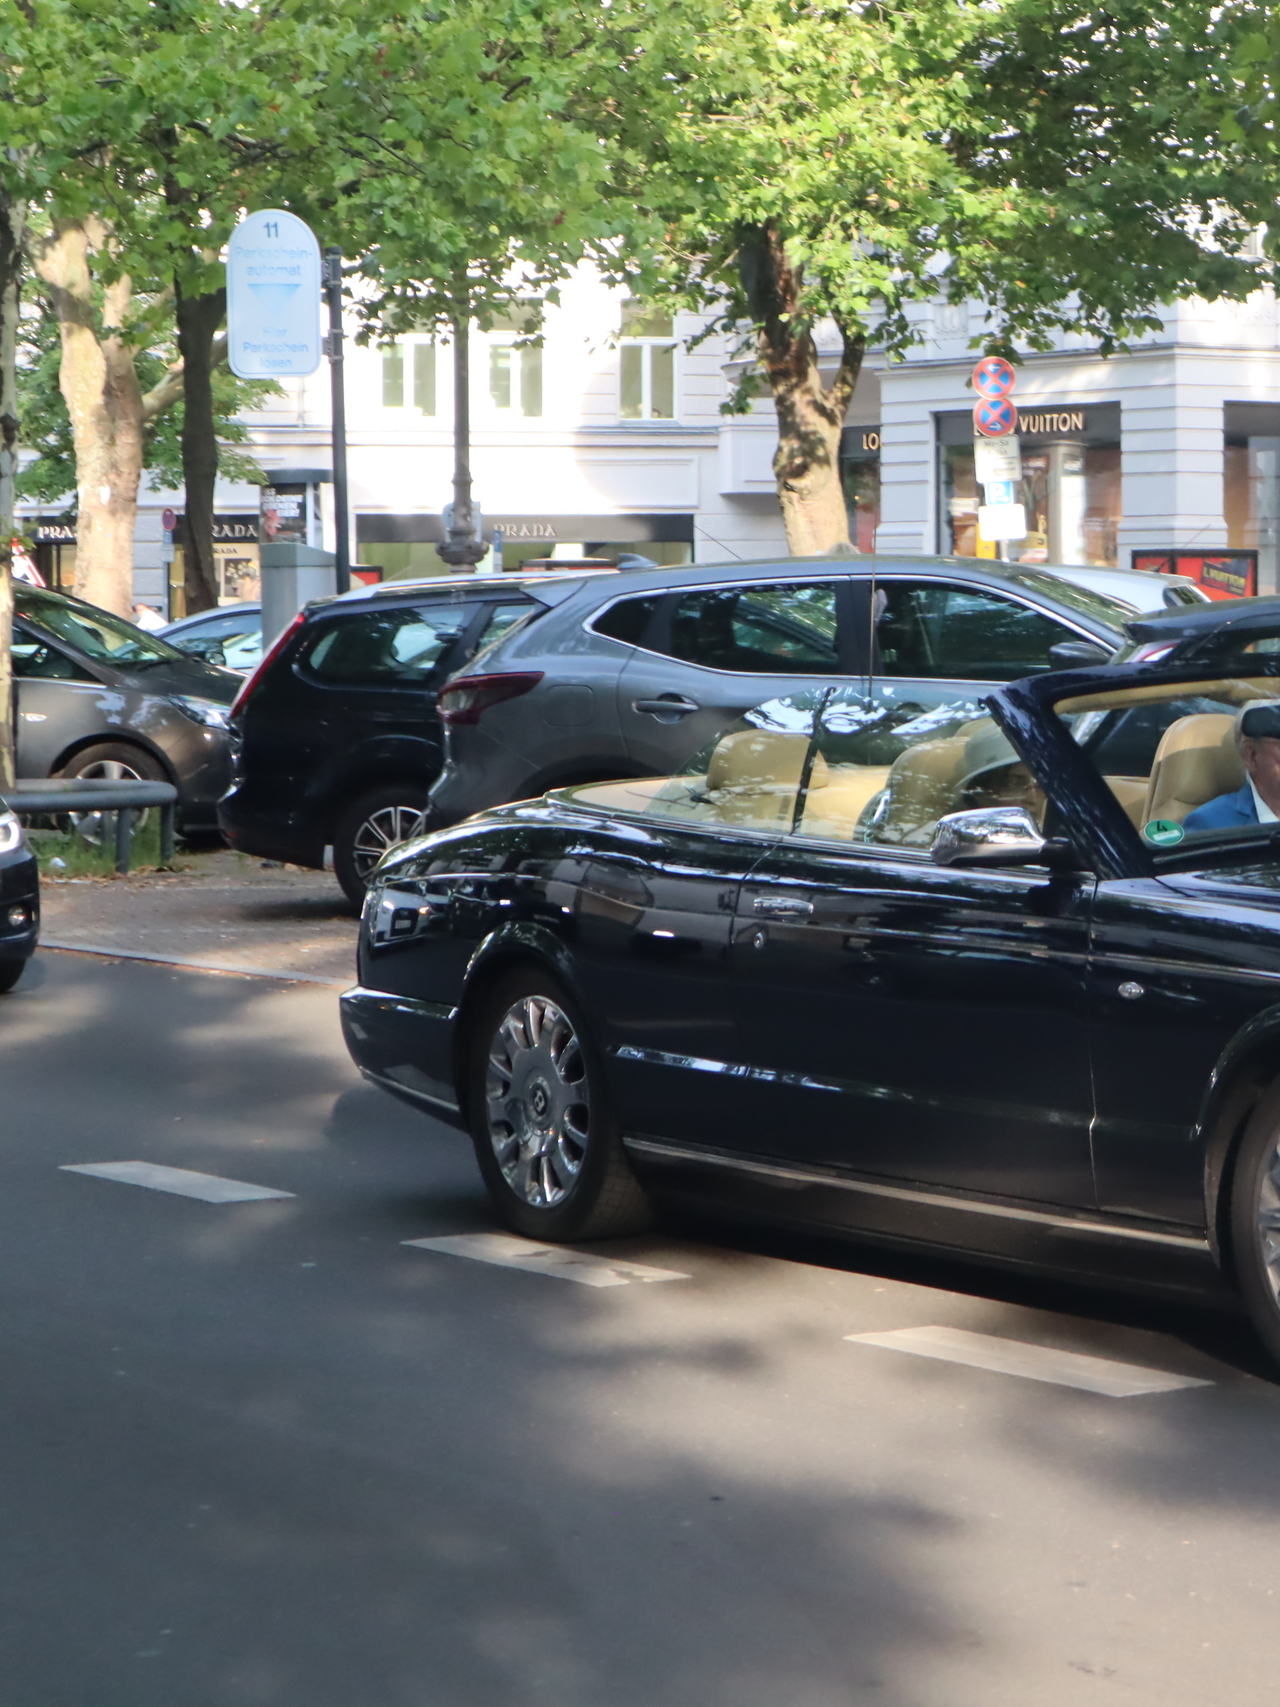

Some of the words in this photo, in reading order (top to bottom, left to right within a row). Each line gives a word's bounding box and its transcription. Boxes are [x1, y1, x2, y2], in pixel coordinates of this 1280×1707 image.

[262, 221, 280, 239] 11
[235, 246, 313, 259] Parkschein-
[246, 264, 302, 276] automat
[243, 341, 309, 353] Parkschein
[1019, 412, 1084, 433] VUITTON
[862, 432, 884, 450] LO
[39, 525, 78, 539] PRA
[211, 524, 258, 538] RADA
[493, 523, 557, 537] PRADA
